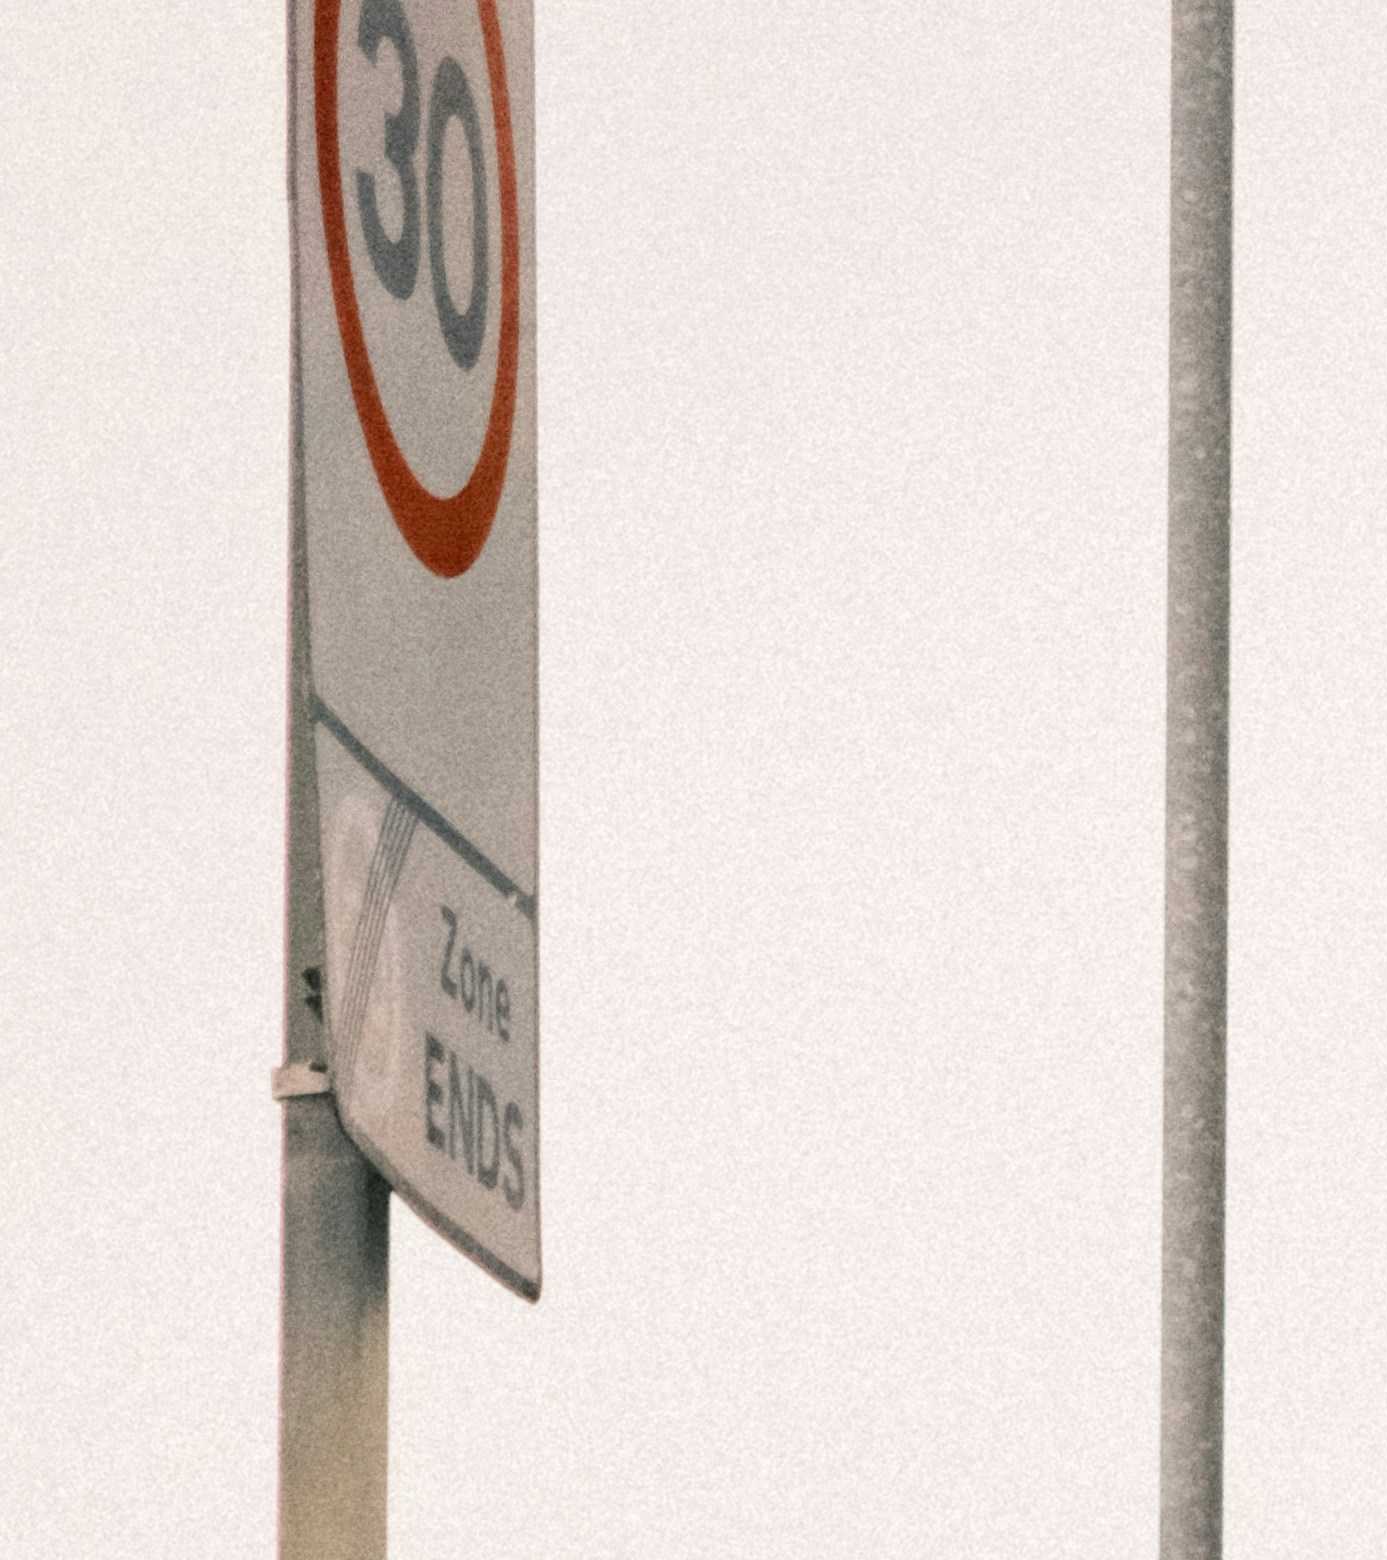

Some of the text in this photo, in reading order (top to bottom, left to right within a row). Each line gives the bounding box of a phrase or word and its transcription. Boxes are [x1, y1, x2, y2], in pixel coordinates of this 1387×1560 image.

[356, 0, 490, 373] 30
[439, 904, 512, 1046] Zone
[424, 1029, 526, 1212] ENDS
